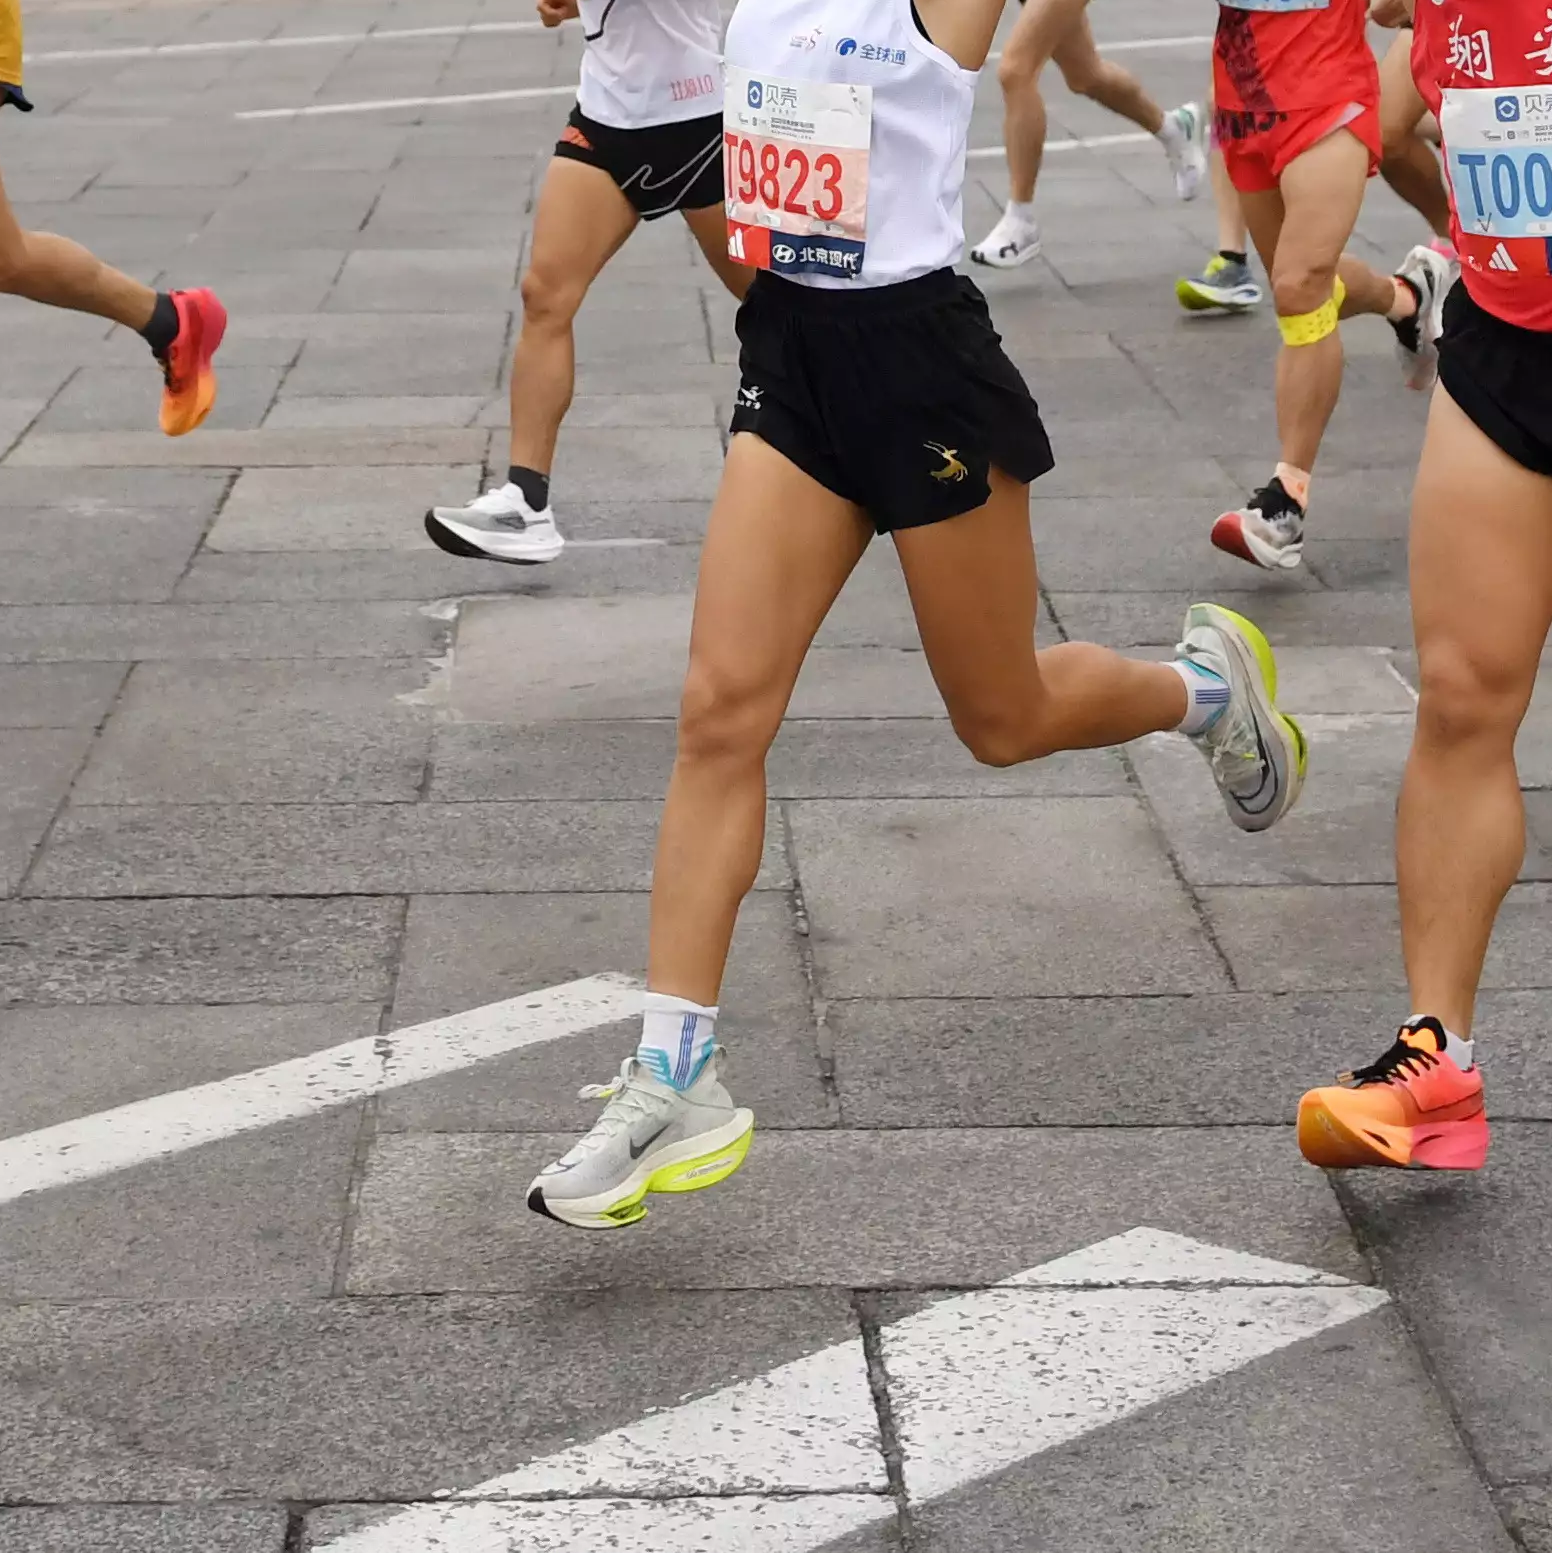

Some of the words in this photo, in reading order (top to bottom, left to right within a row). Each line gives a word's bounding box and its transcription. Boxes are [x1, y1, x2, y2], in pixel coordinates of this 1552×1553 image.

[860, 43, 907, 65] 全球通
[766, 84, 798, 108] 贝壳
[724, 132, 843, 222] T9823
[799, 247, 860, 271] 北京现代
